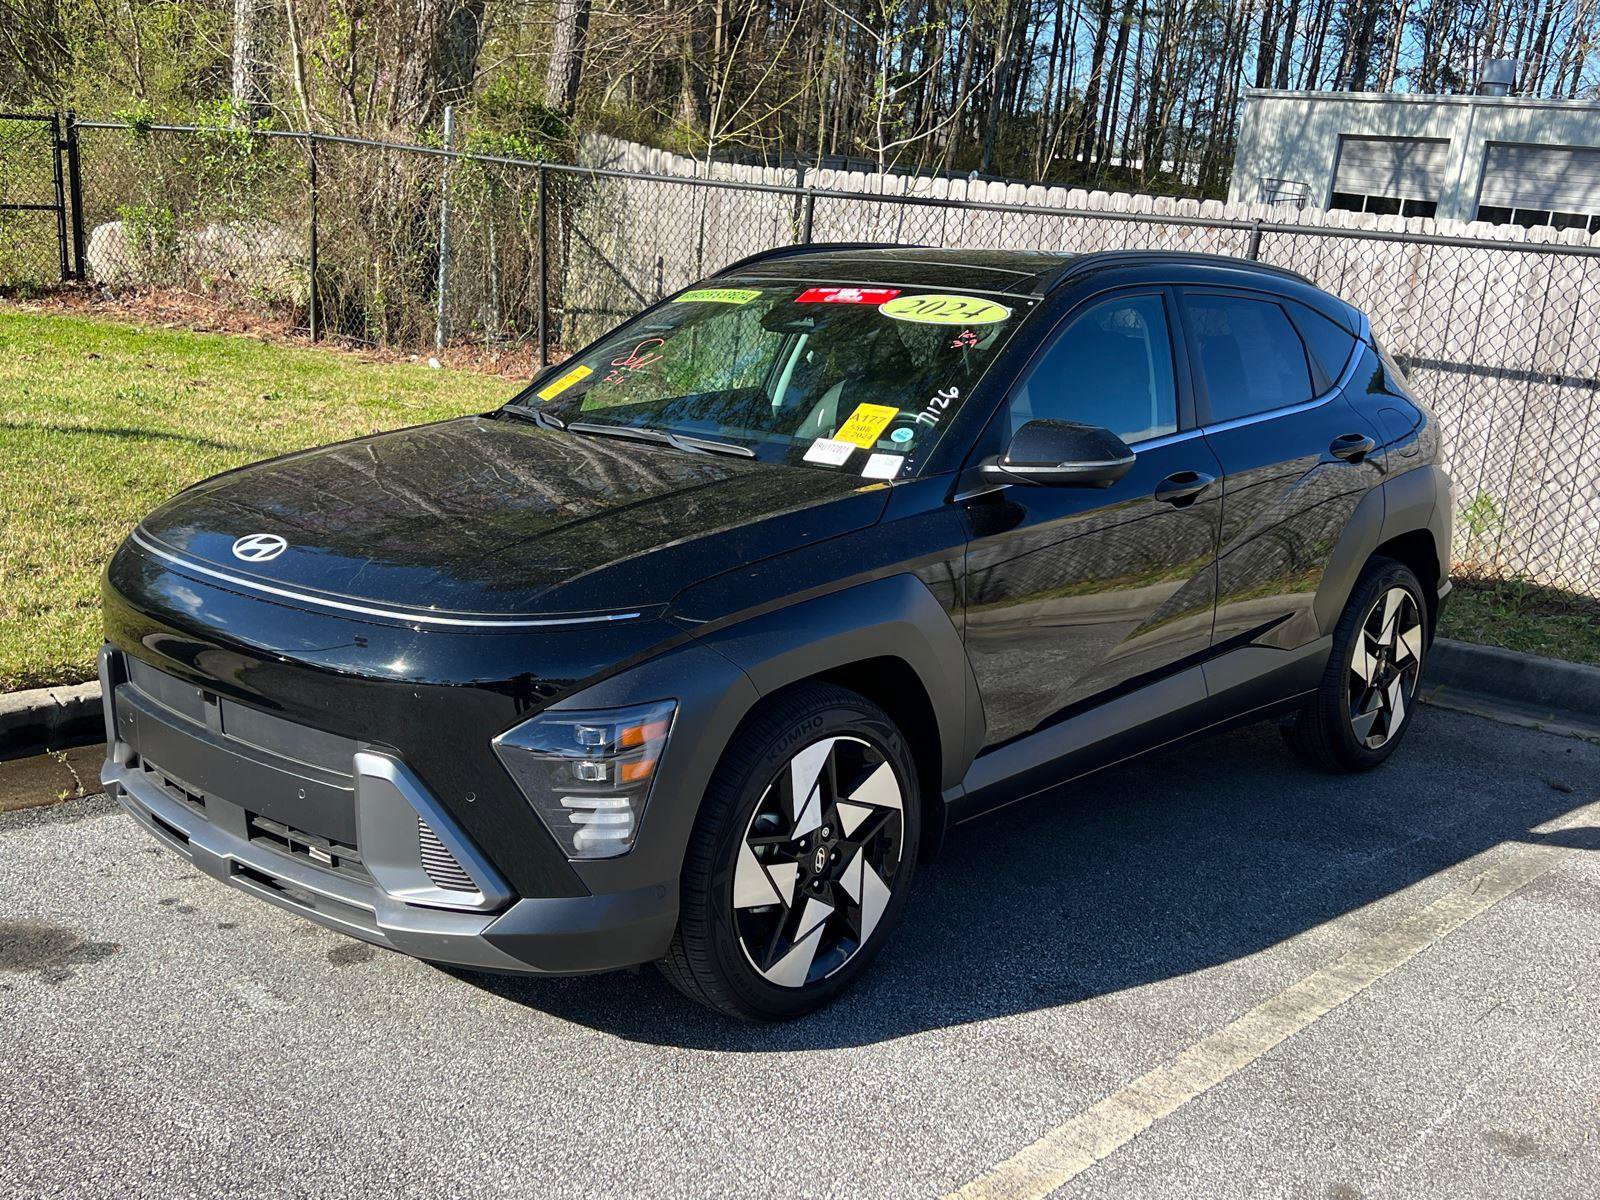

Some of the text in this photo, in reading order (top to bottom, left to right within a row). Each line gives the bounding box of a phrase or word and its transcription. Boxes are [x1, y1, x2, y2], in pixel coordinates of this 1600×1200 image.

[892, 299, 994, 319] 2024
[849, 413, 888, 425] A177
[765, 716, 824, 764] KUMHO
